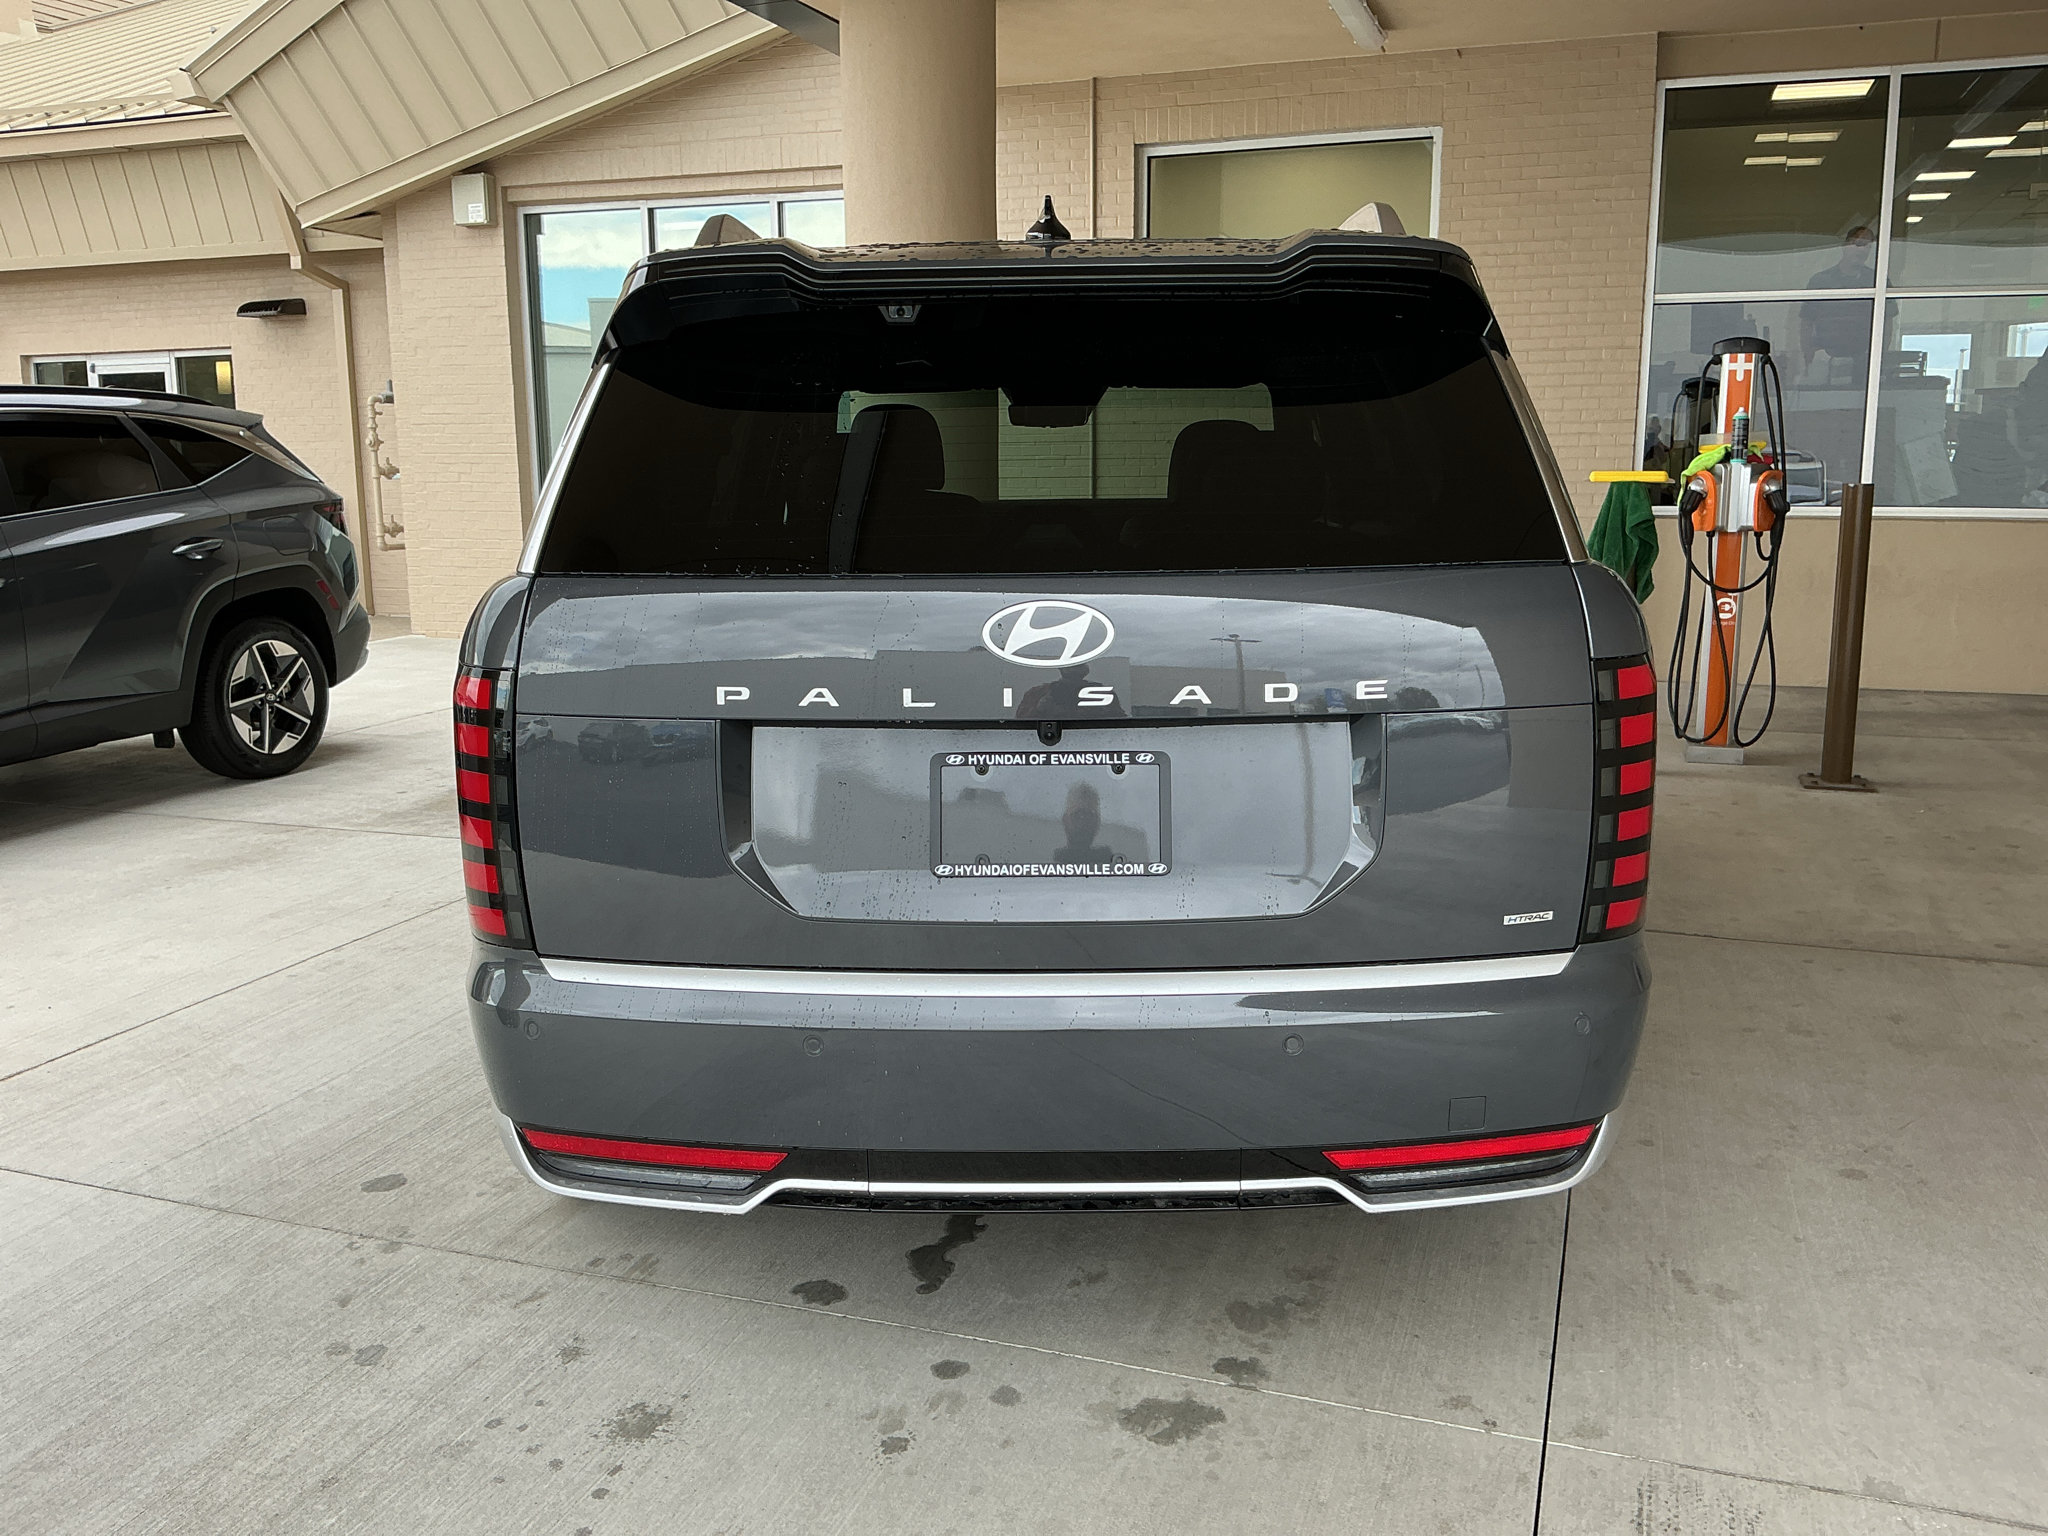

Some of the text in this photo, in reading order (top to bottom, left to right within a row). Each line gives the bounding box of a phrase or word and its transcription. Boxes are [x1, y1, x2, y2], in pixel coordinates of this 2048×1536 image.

[716, 679, 1389, 707] PALISADE
[968, 753, 1130, 765] HYUNDAI OF EVANSVILLE
[955, 863, 1144, 876] HYUNDAIOFEVANSVILLE.COM
[1507, 912, 1551, 923] HTRAC
